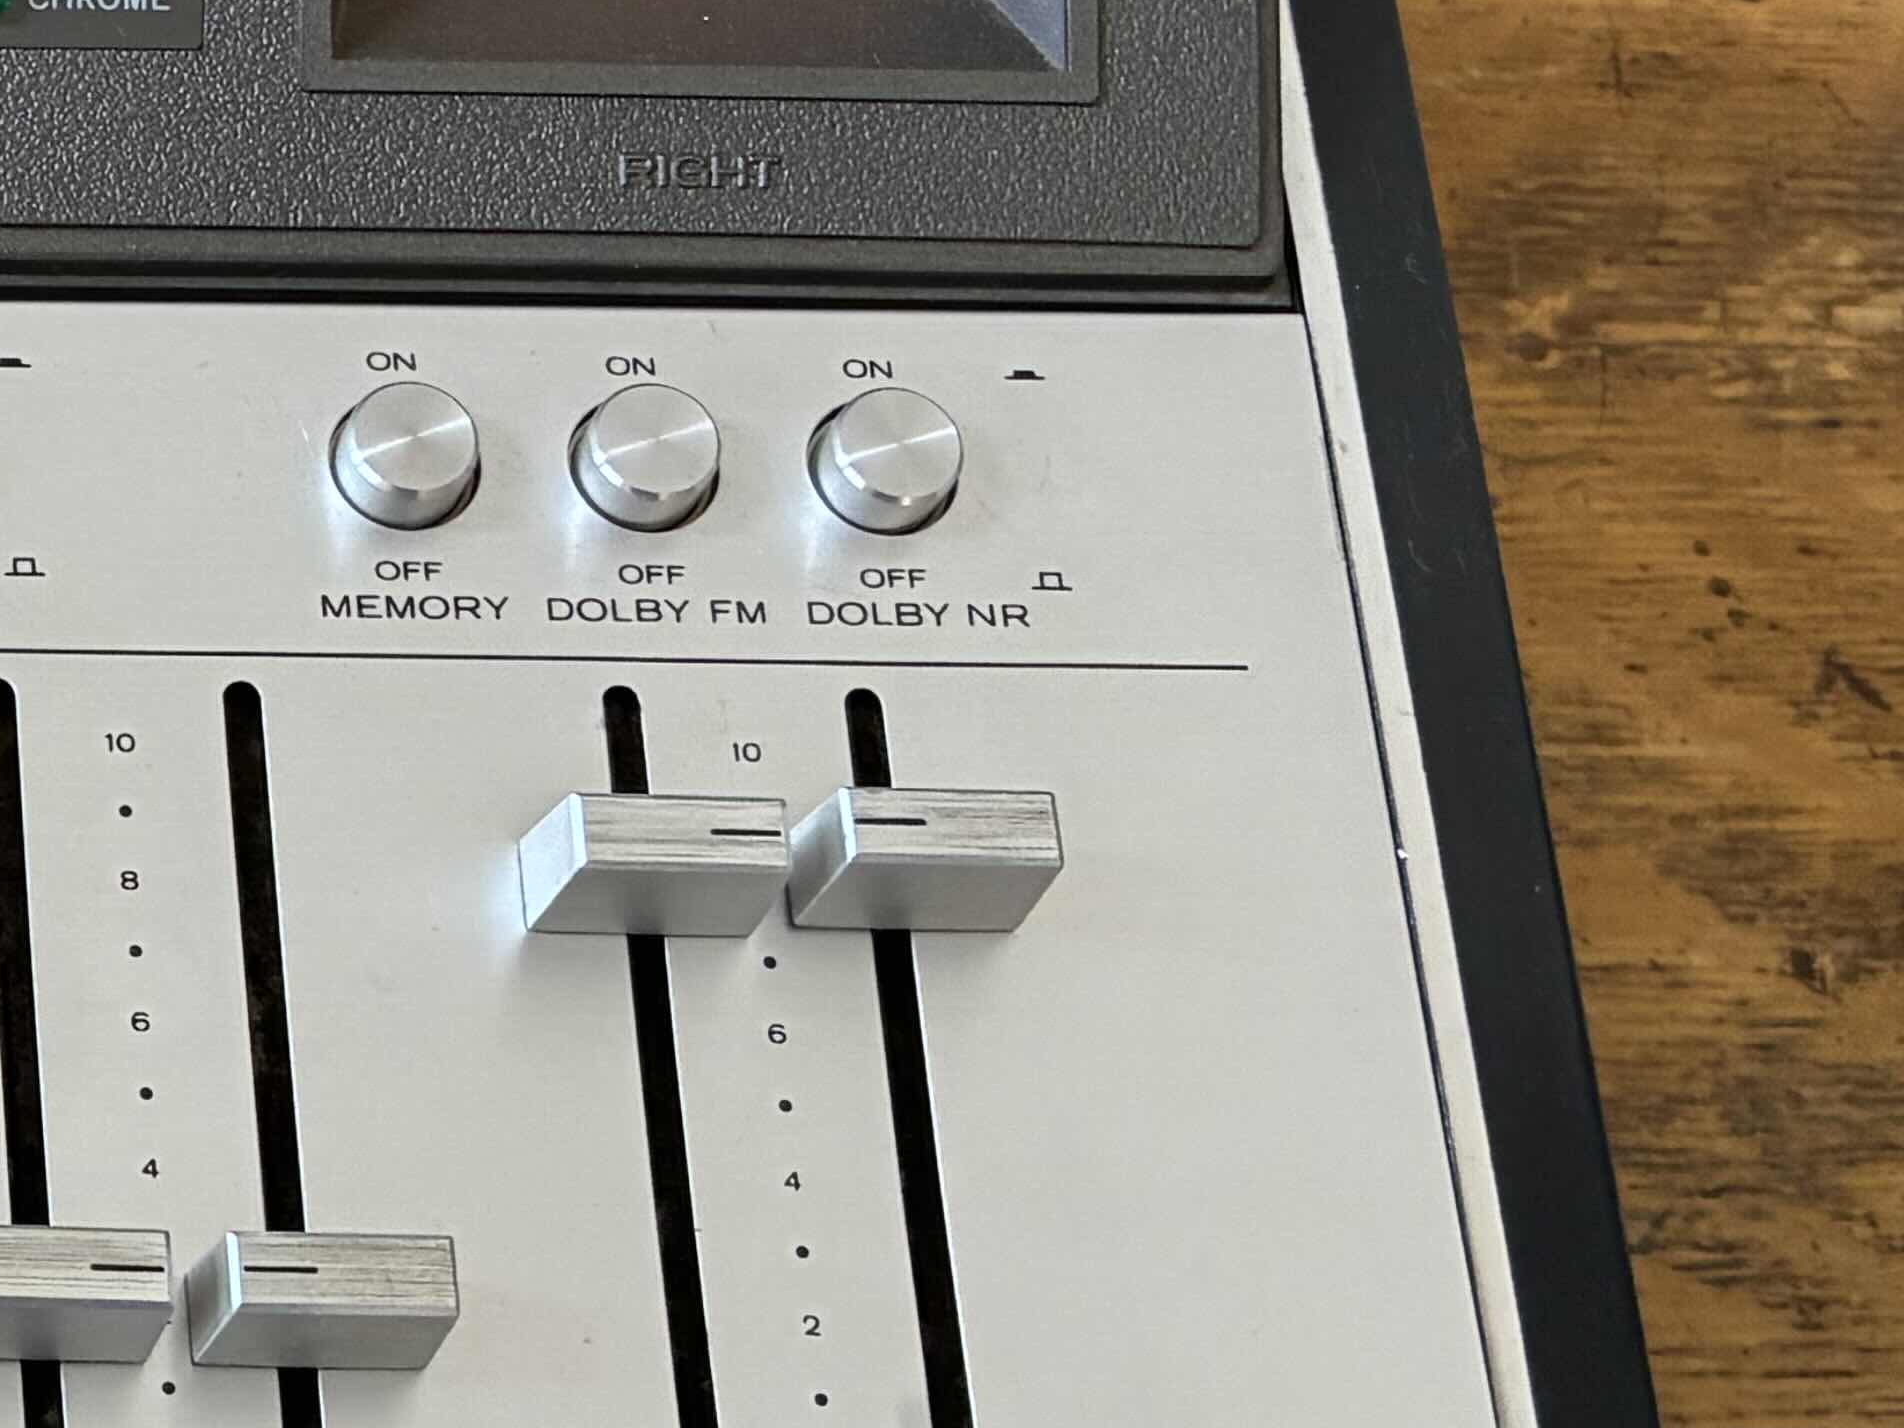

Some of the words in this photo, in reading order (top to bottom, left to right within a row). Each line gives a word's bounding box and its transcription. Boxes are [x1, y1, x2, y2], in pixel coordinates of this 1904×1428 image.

[618, 152, 781, 189] RIGHT
[365, 351, 417, 372] ON
[605, 356, 656, 376] ON
[842, 358, 893, 379] ON
[374, 560, 443, 581] OFF
[618, 564, 685, 585] OFF
[859, 568, 926, 589] OFF
[321, 594, 509, 620] MEMORY
[547, 597, 689, 623] DOLBY
[710, 599, 767, 624] FM
[807, 601, 950, 627] DOLBY
[967, 603, 1030, 628] NR
[104, 732, 136, 753] 10
[732, 742, 762, 763] 10
[120, 870, 140, 891] 8
[131, 1011, 151, 1032] 6
[767, 1023, 787, 1045] 6
[141, 1158, 160, 1179] 4
[784, 1171, 801, 1191] 4
[802, 1314, 821, 1337] 2
